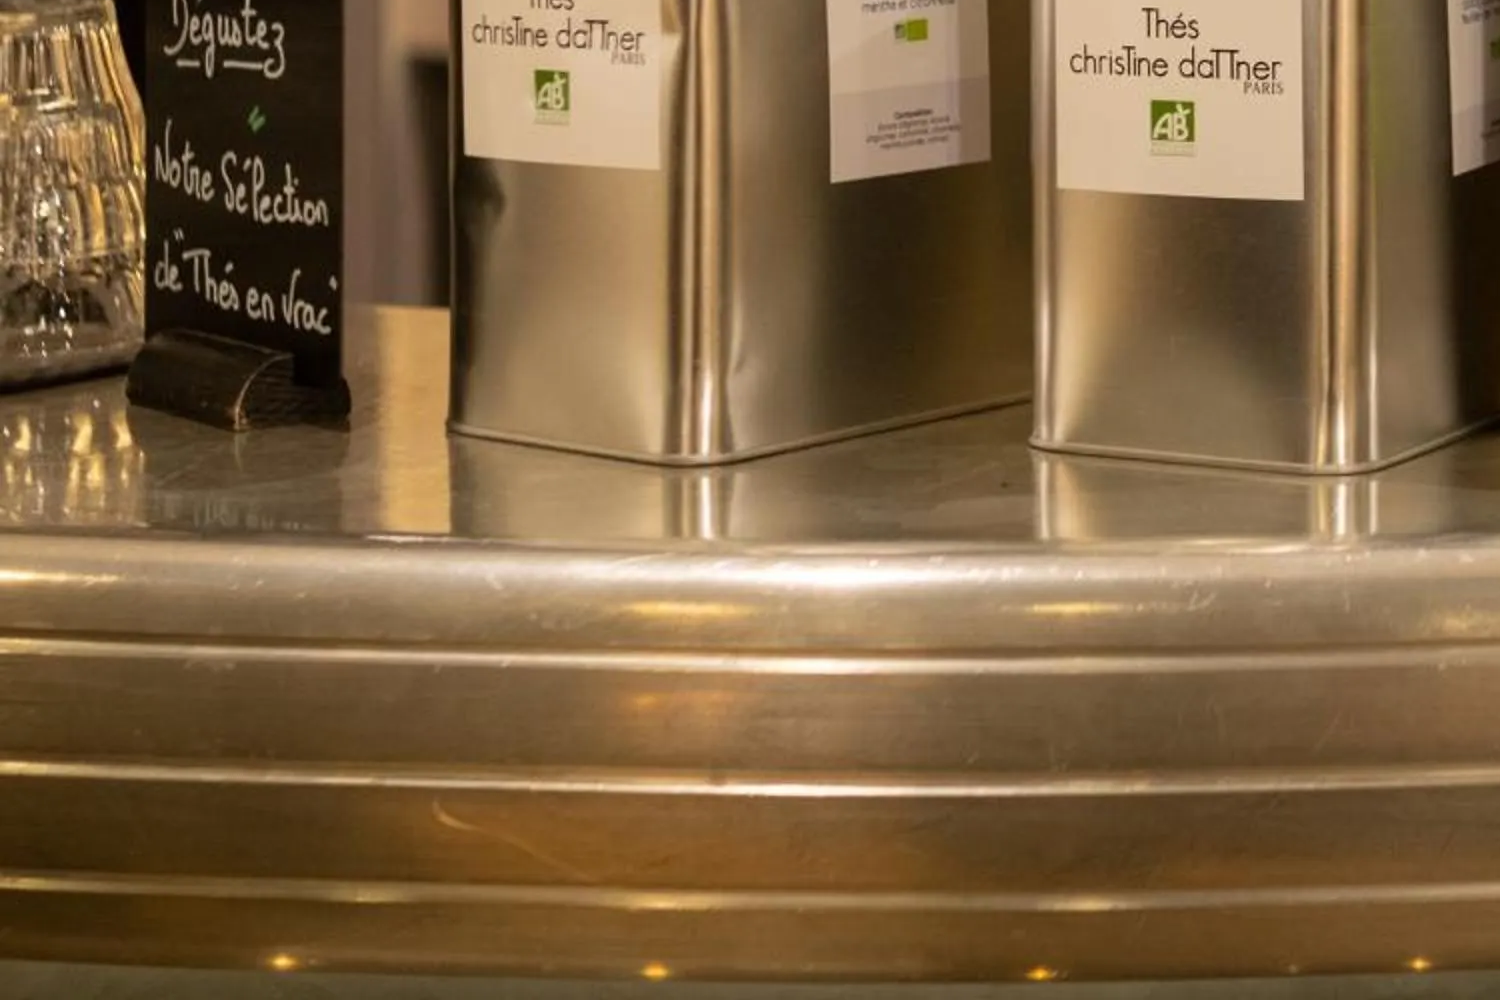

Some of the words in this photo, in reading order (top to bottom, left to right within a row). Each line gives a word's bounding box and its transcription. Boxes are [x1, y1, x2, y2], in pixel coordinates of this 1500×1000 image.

[1142, 8, 1200, 38] Thés
[537, 82, 564, 109] AB
[1244, 81, 1284, 95] PARIS
[1153, 112, 1189, 140] AB
[155, 118, 214, 201] Notre
[222, 151, 328, 226] Sélection
[155, 239, 183, 292] de
[246, 287, 274, 321] en
